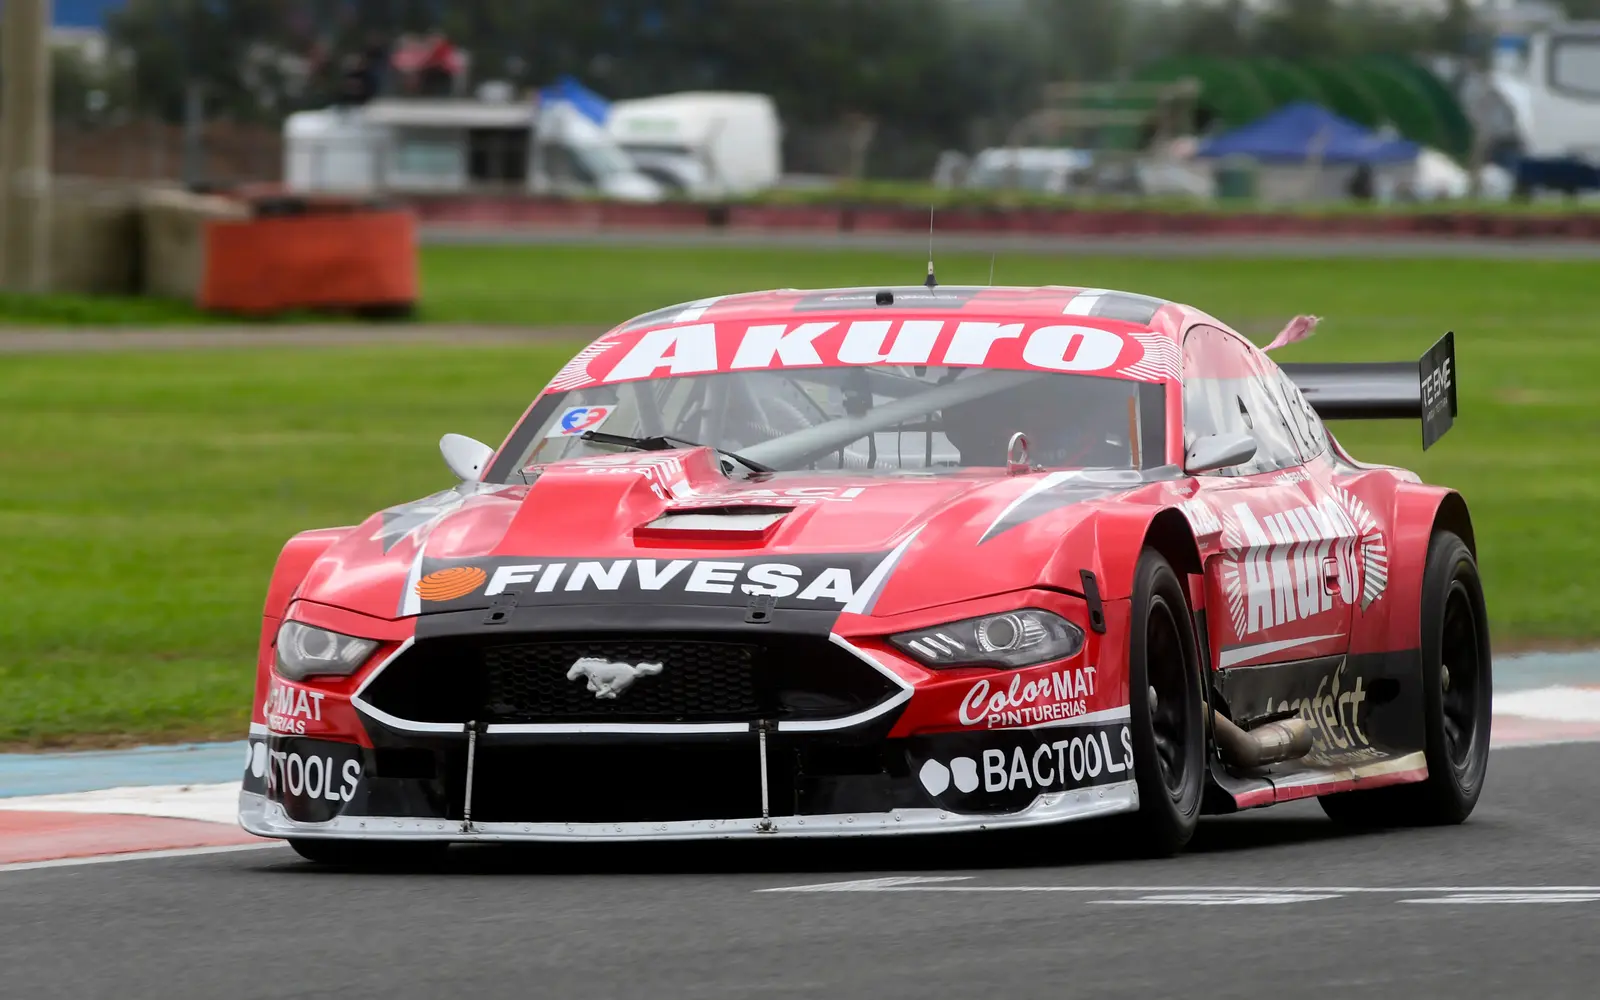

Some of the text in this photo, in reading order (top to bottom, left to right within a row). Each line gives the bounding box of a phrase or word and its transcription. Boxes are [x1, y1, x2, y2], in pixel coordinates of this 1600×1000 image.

[602, 319, 1124, 382] Akuro
[485, 558, 857, 604] FINVESA
[958, 666, 1097, 726] ColorMAT
[987, 699, 1087, 729] PINTURERIAS
[982, 725, 1135, 793] BACTOOLS
